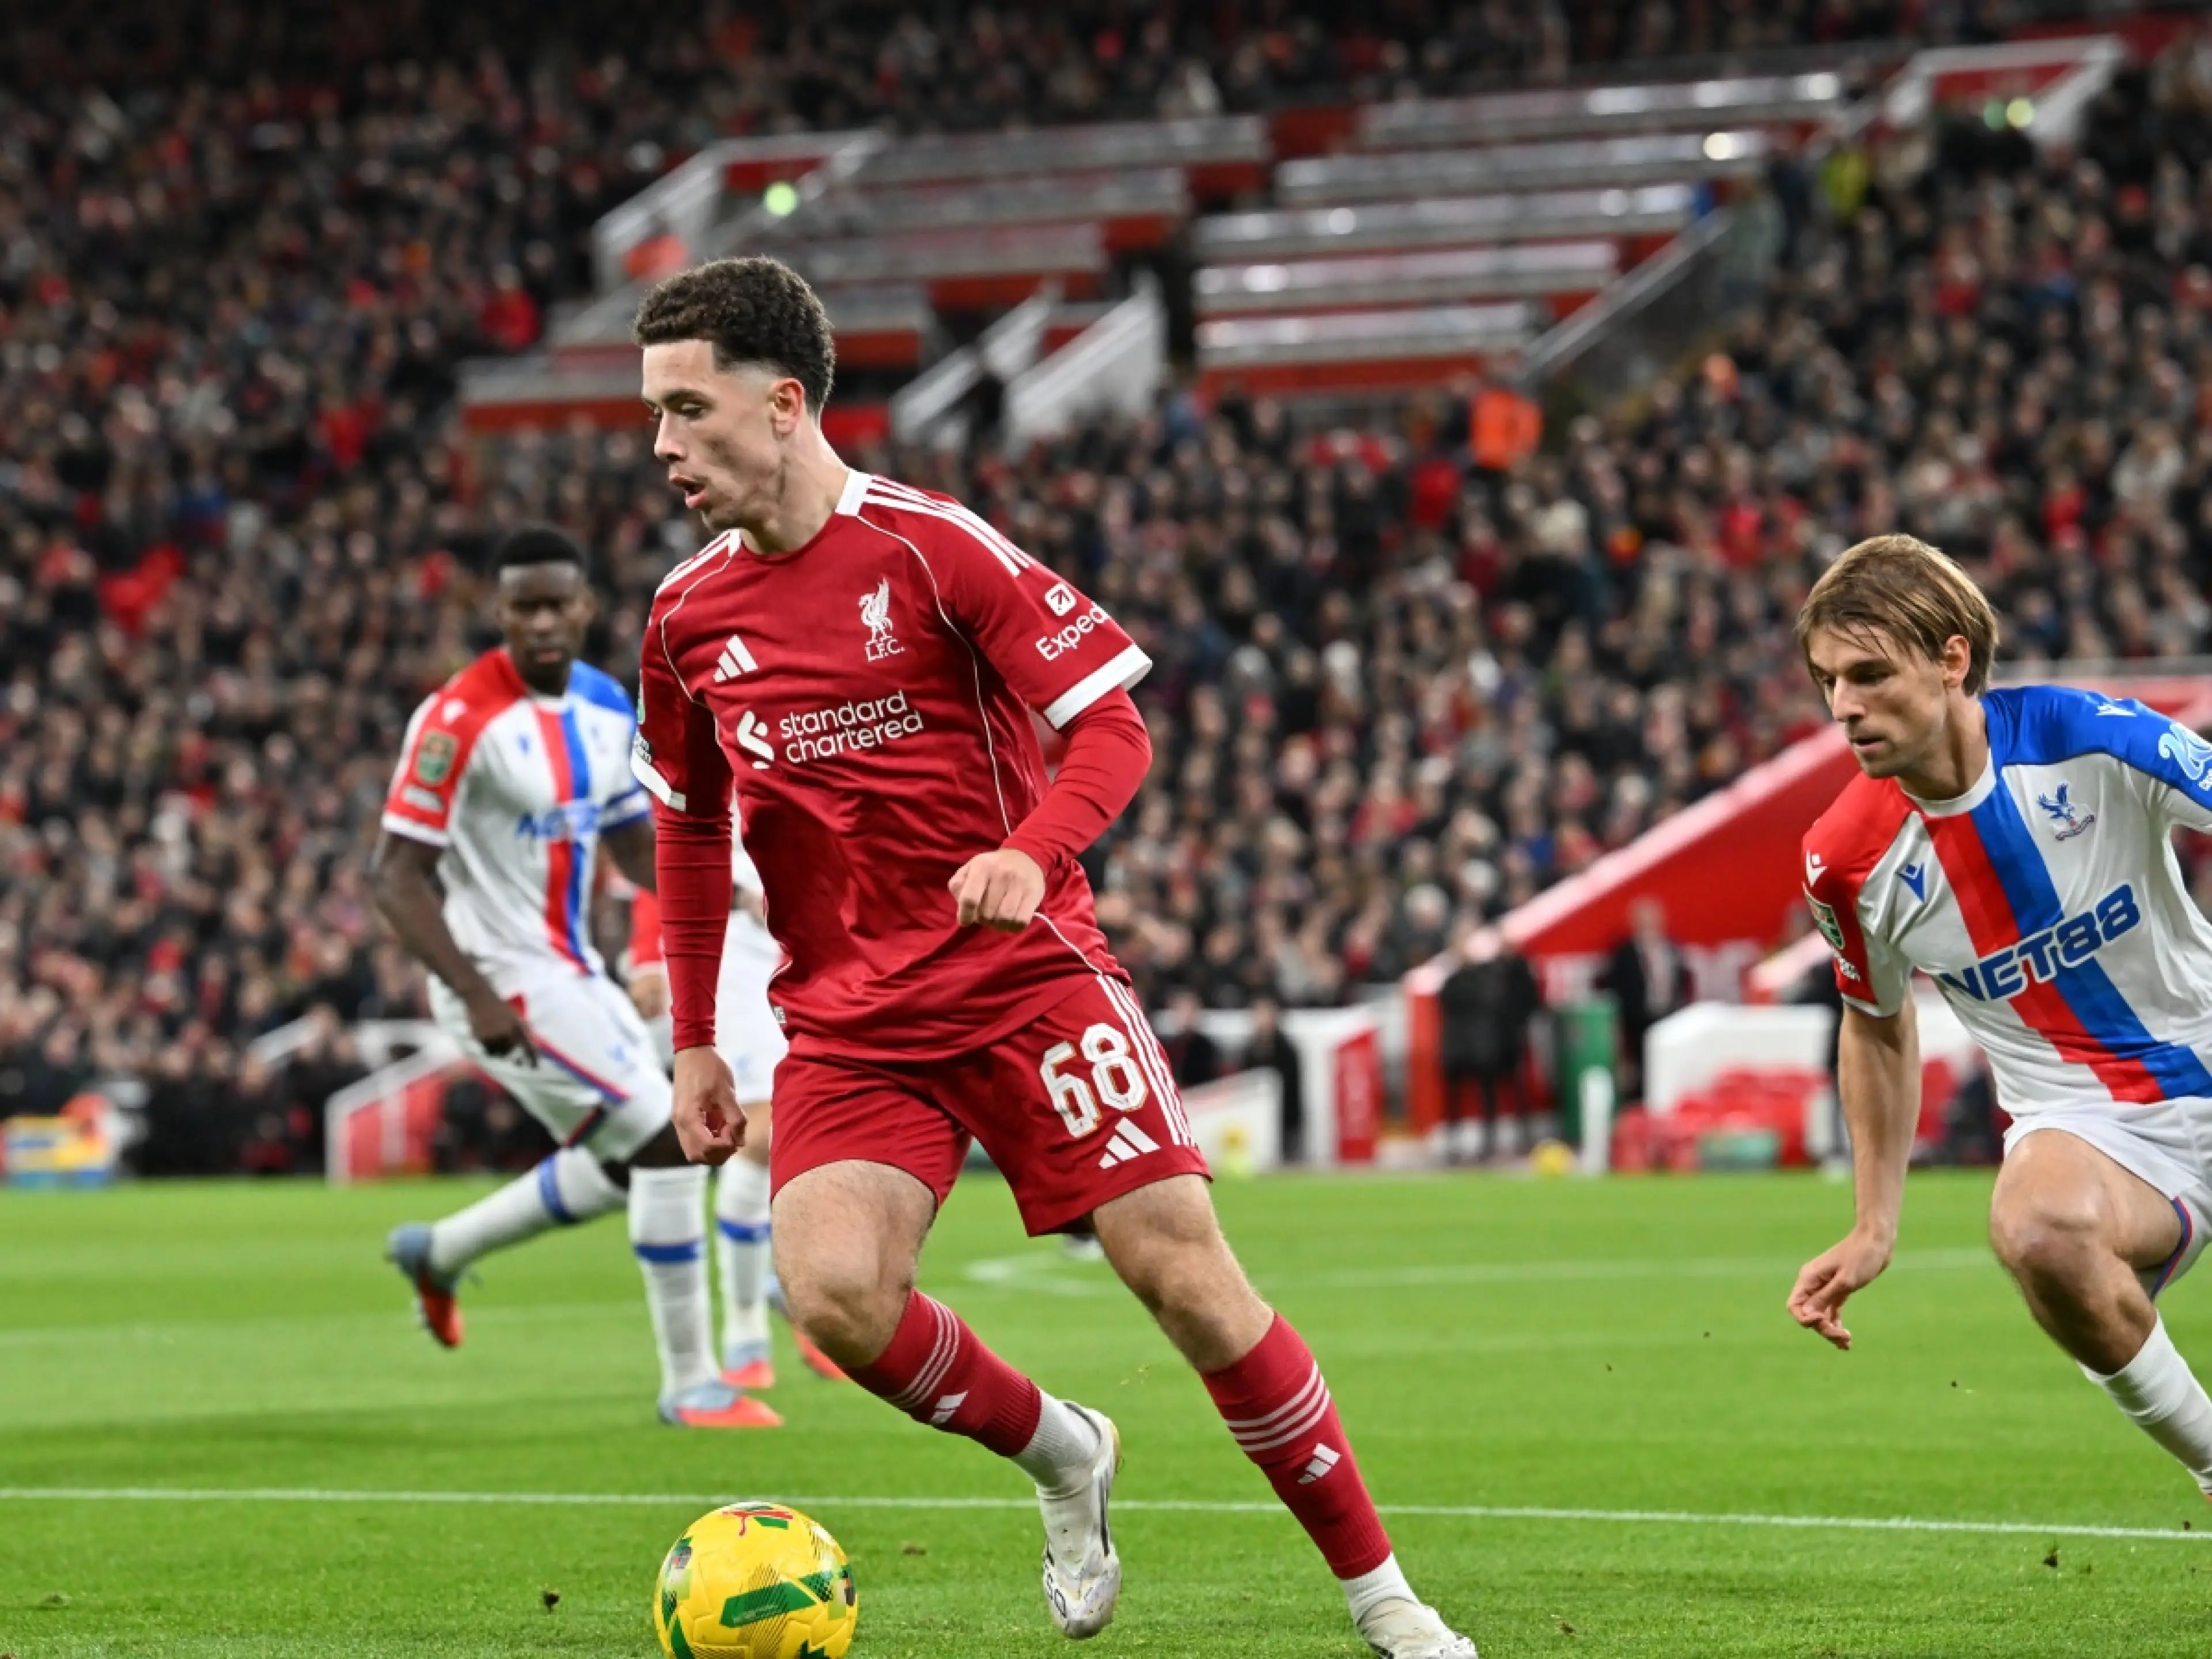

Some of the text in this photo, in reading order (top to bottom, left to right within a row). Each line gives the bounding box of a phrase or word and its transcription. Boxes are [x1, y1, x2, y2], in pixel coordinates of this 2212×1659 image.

[780, 690, 907, 738] standard
[786, 711, 923, 763] chartered
[1939, 884, 2141, 1001] NET88
[1040, 1023, 1149, 1138] 68
